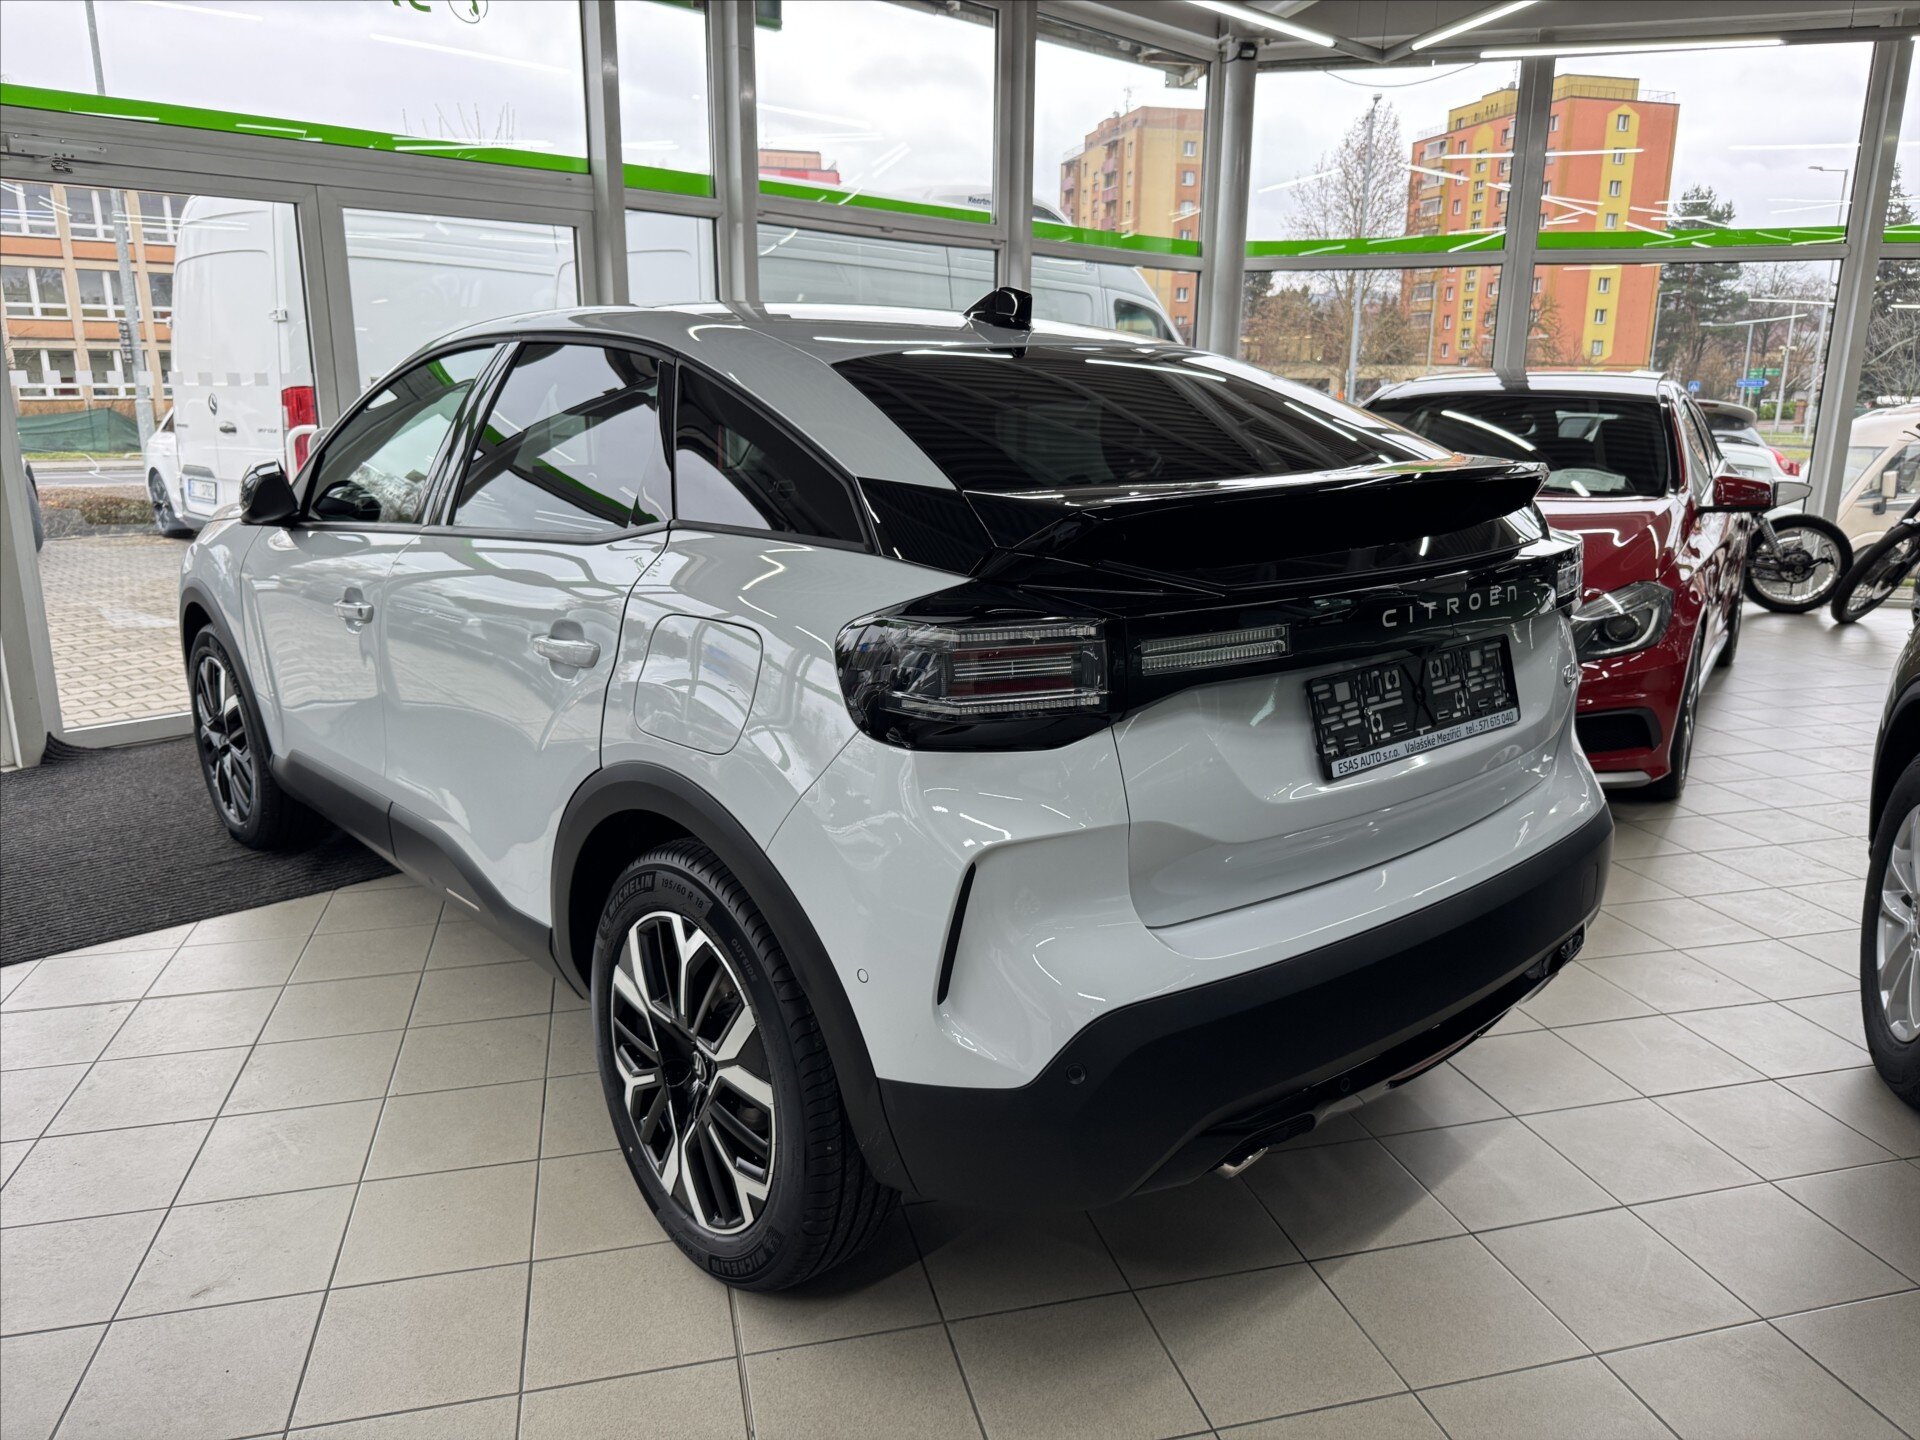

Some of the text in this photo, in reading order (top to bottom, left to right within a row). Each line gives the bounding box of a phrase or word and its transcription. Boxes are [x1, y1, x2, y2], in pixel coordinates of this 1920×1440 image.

[1338, 757, 1359, 774] ESAS
[1360, 752, 1382, 769] AUTO
[608, 874, 653, 918] MICHELIN
[662, 878, 686, 895] 195/60
[695, 896, 704, 909] 18
[731, 938, 758, 983] OUTSIDE
